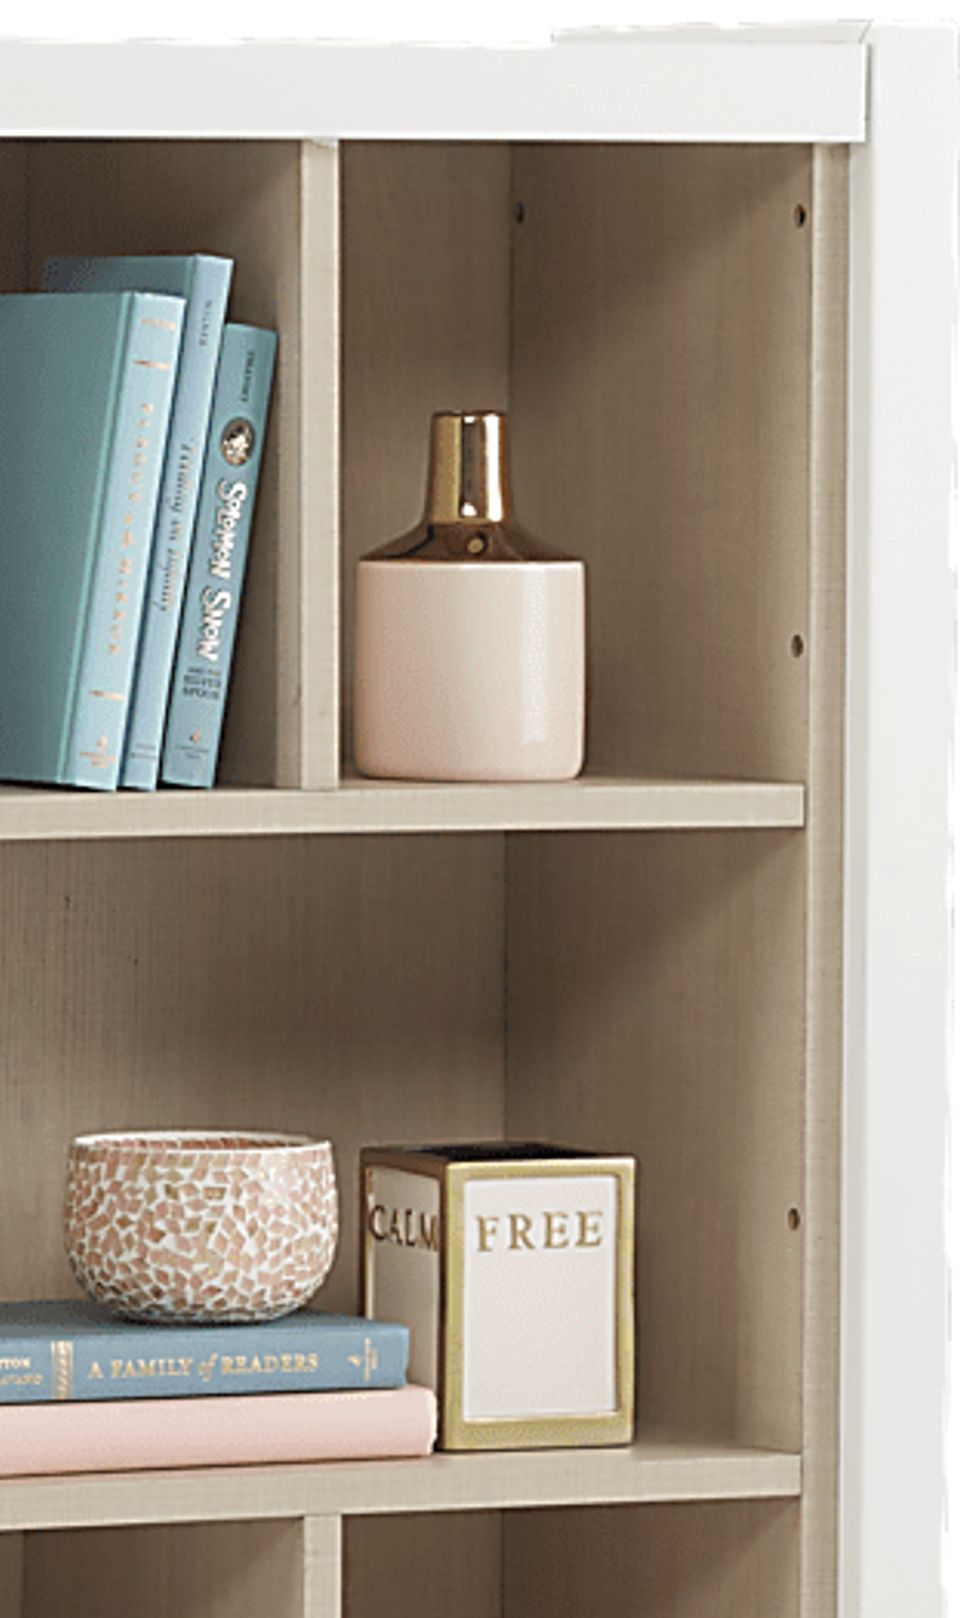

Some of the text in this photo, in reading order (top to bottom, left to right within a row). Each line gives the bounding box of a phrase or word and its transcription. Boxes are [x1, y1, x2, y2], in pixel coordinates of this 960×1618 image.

[209, 479, 247, 579] SOLOMON
[197, 586, 231, 661] SNOW
[476, 1211, 603, 1252] FREE
[88, 1352, 319, 1382] A FAMILY of READERS
